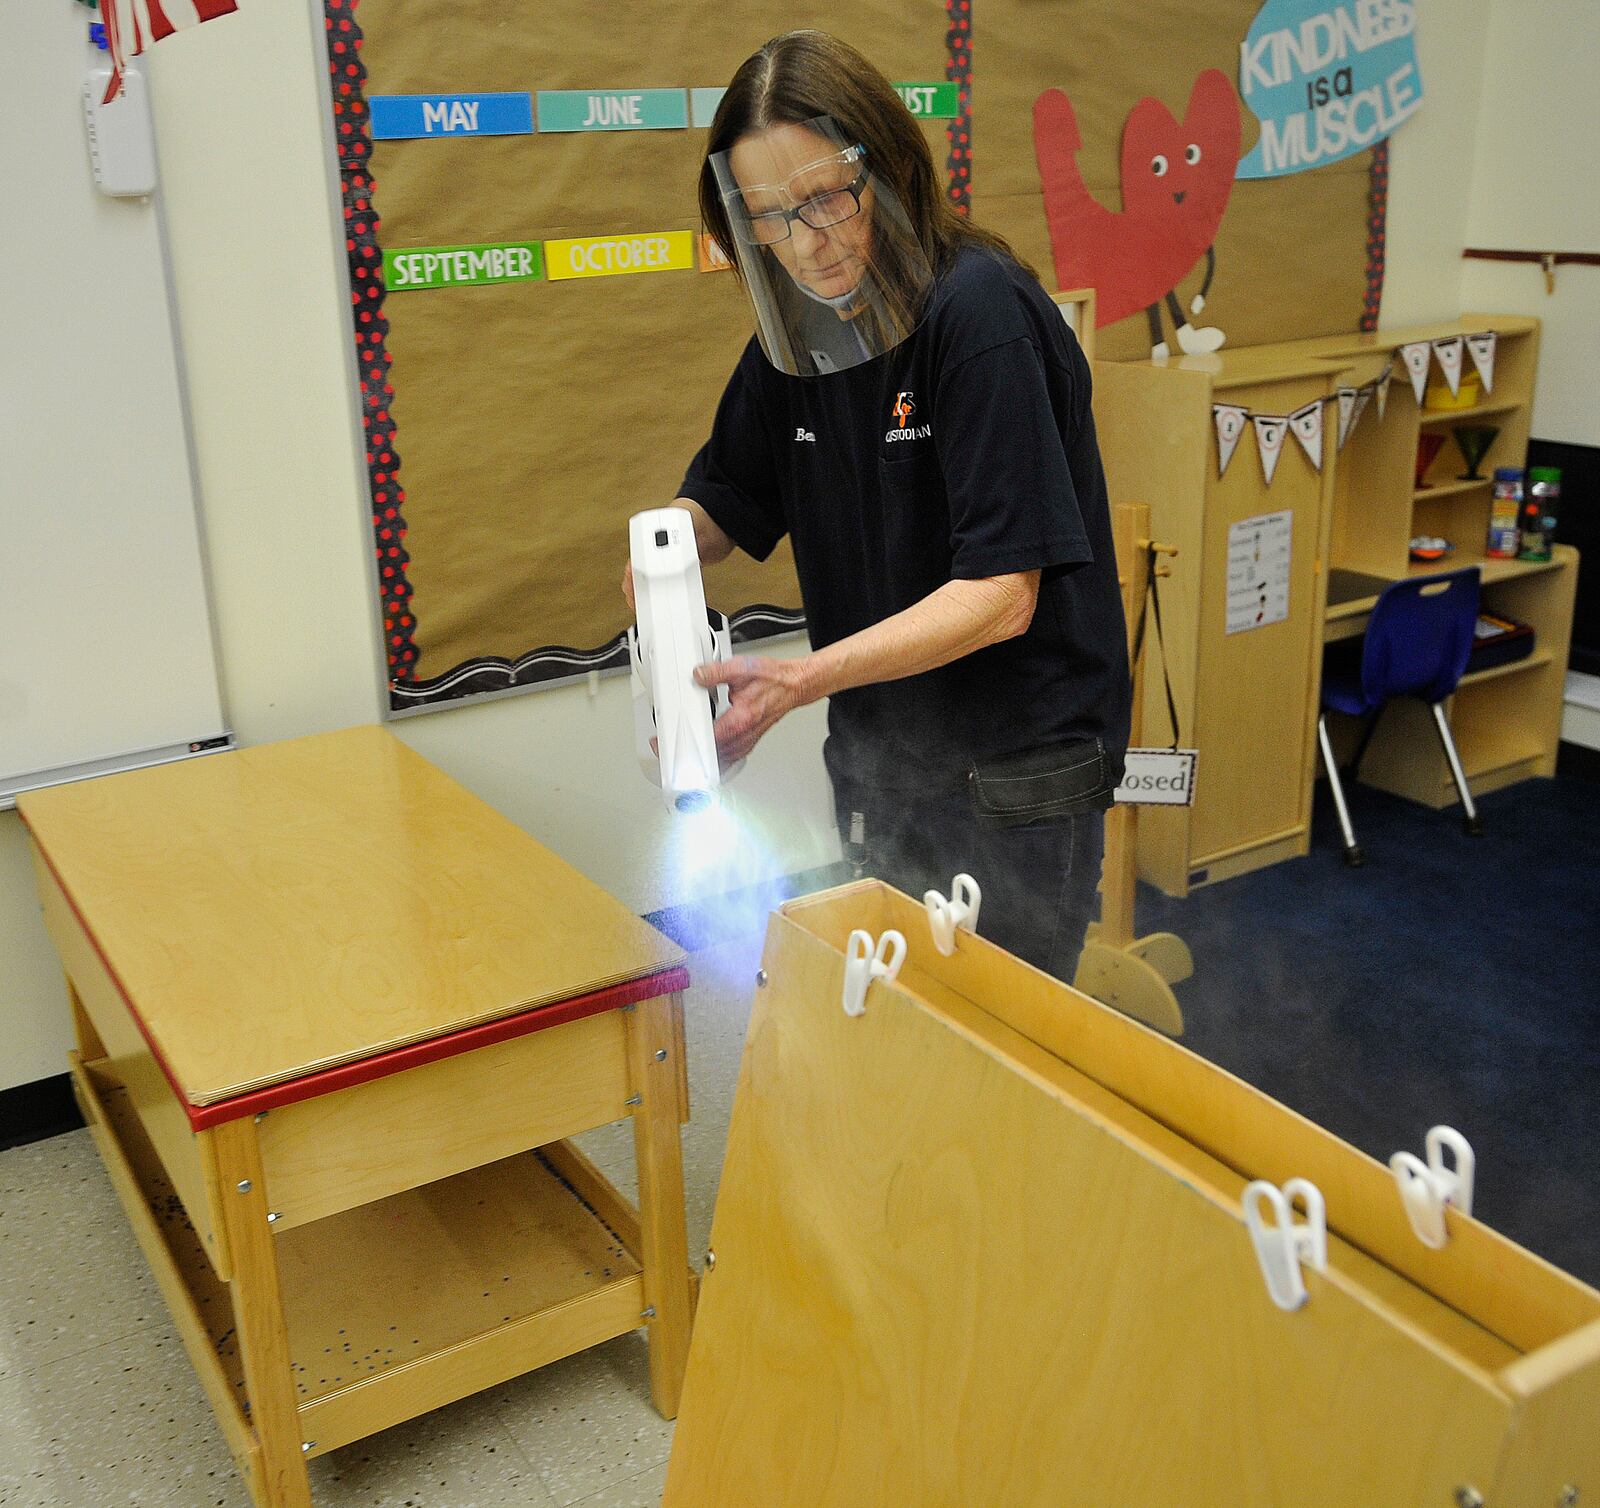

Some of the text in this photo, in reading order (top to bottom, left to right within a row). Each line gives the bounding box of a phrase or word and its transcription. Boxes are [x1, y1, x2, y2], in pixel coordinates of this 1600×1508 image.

[1240, 0, 1416, 95] KINDNESS
[422, 101, 479, 132] MAY
[583, 95, 642, 126] JUNE
[1261, 63, 1423, 172] MUSCLE
[393, 247, 533, 285] SEPTEMBER
[569, 237, 670, 272] OCTOBER
[1122, 771, 1186, 791] osed
